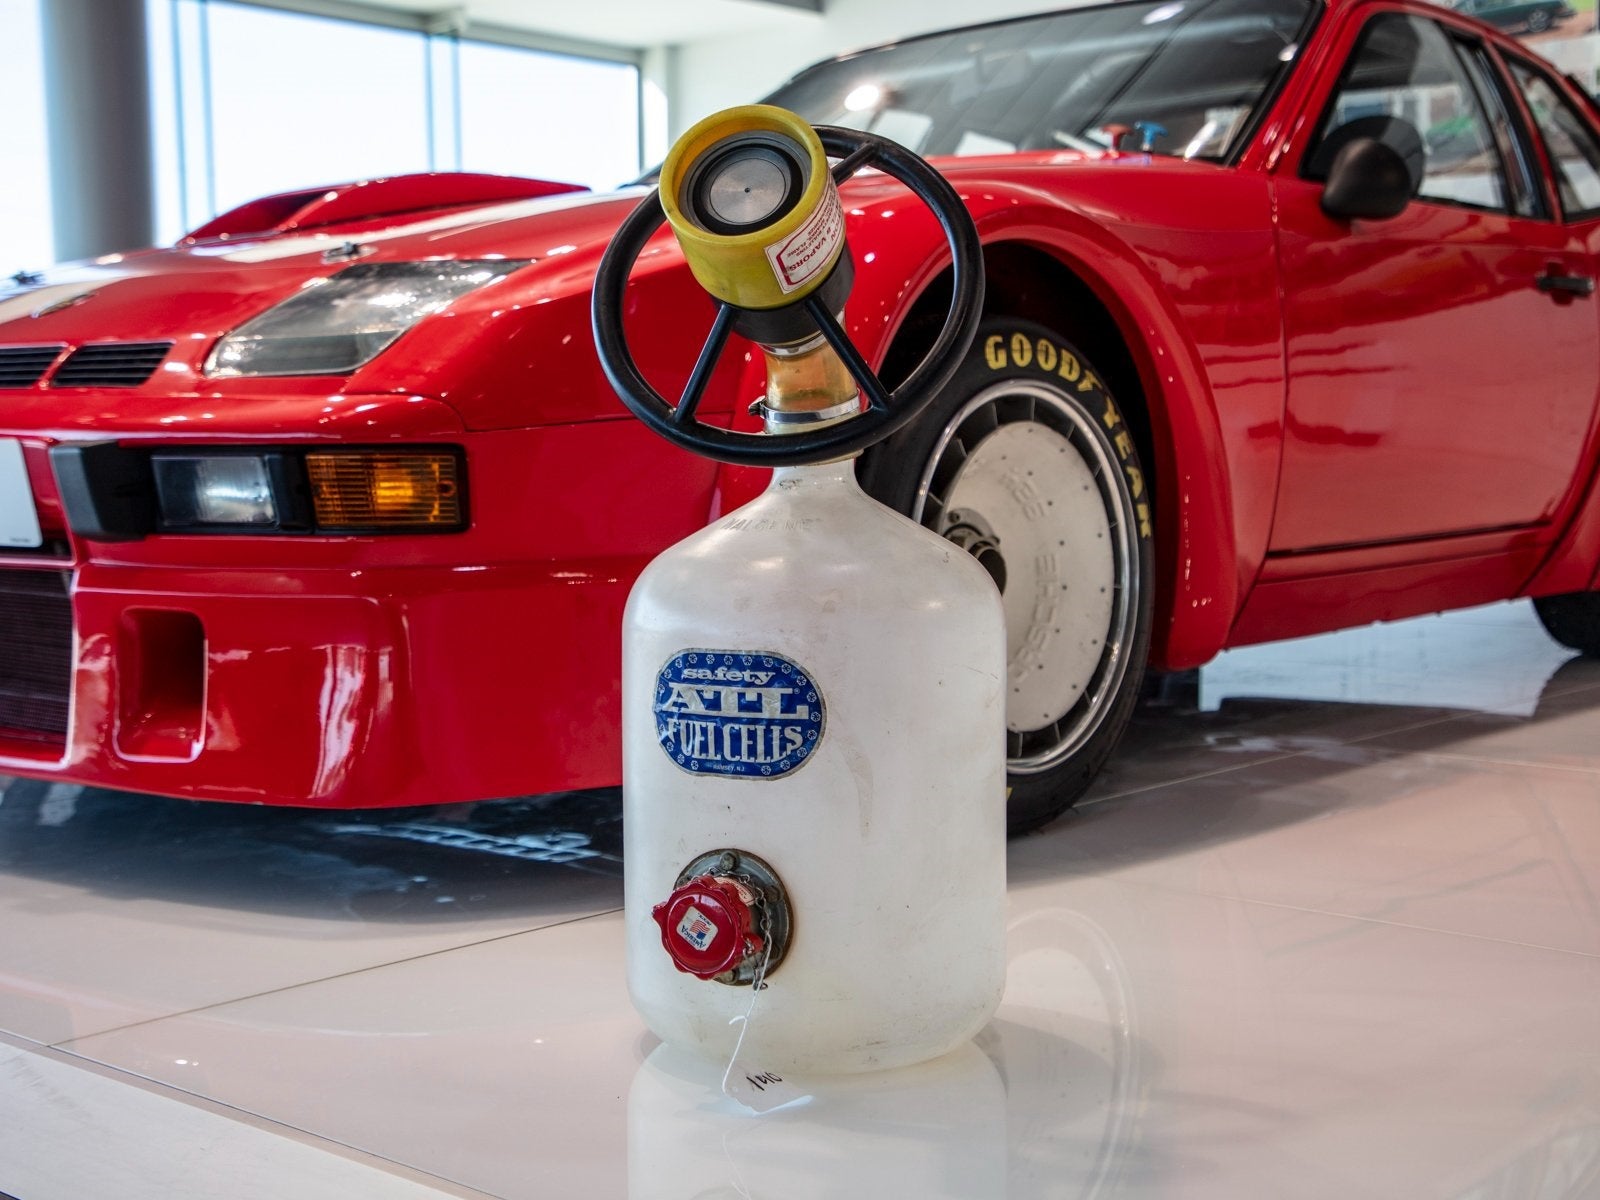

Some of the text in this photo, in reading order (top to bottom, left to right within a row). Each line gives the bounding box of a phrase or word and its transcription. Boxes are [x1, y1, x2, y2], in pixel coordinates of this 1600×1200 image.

[788, 236, 827, 272] VAPORS
[984, 332, 1152, 538] GOODYEAR
[682, 666, 776, 685] safety
[661, 682, 809, 720] ATL
[666, 718, 804, 763] FUEL CELLS
[680, 924, 707, 949] AMERICA
